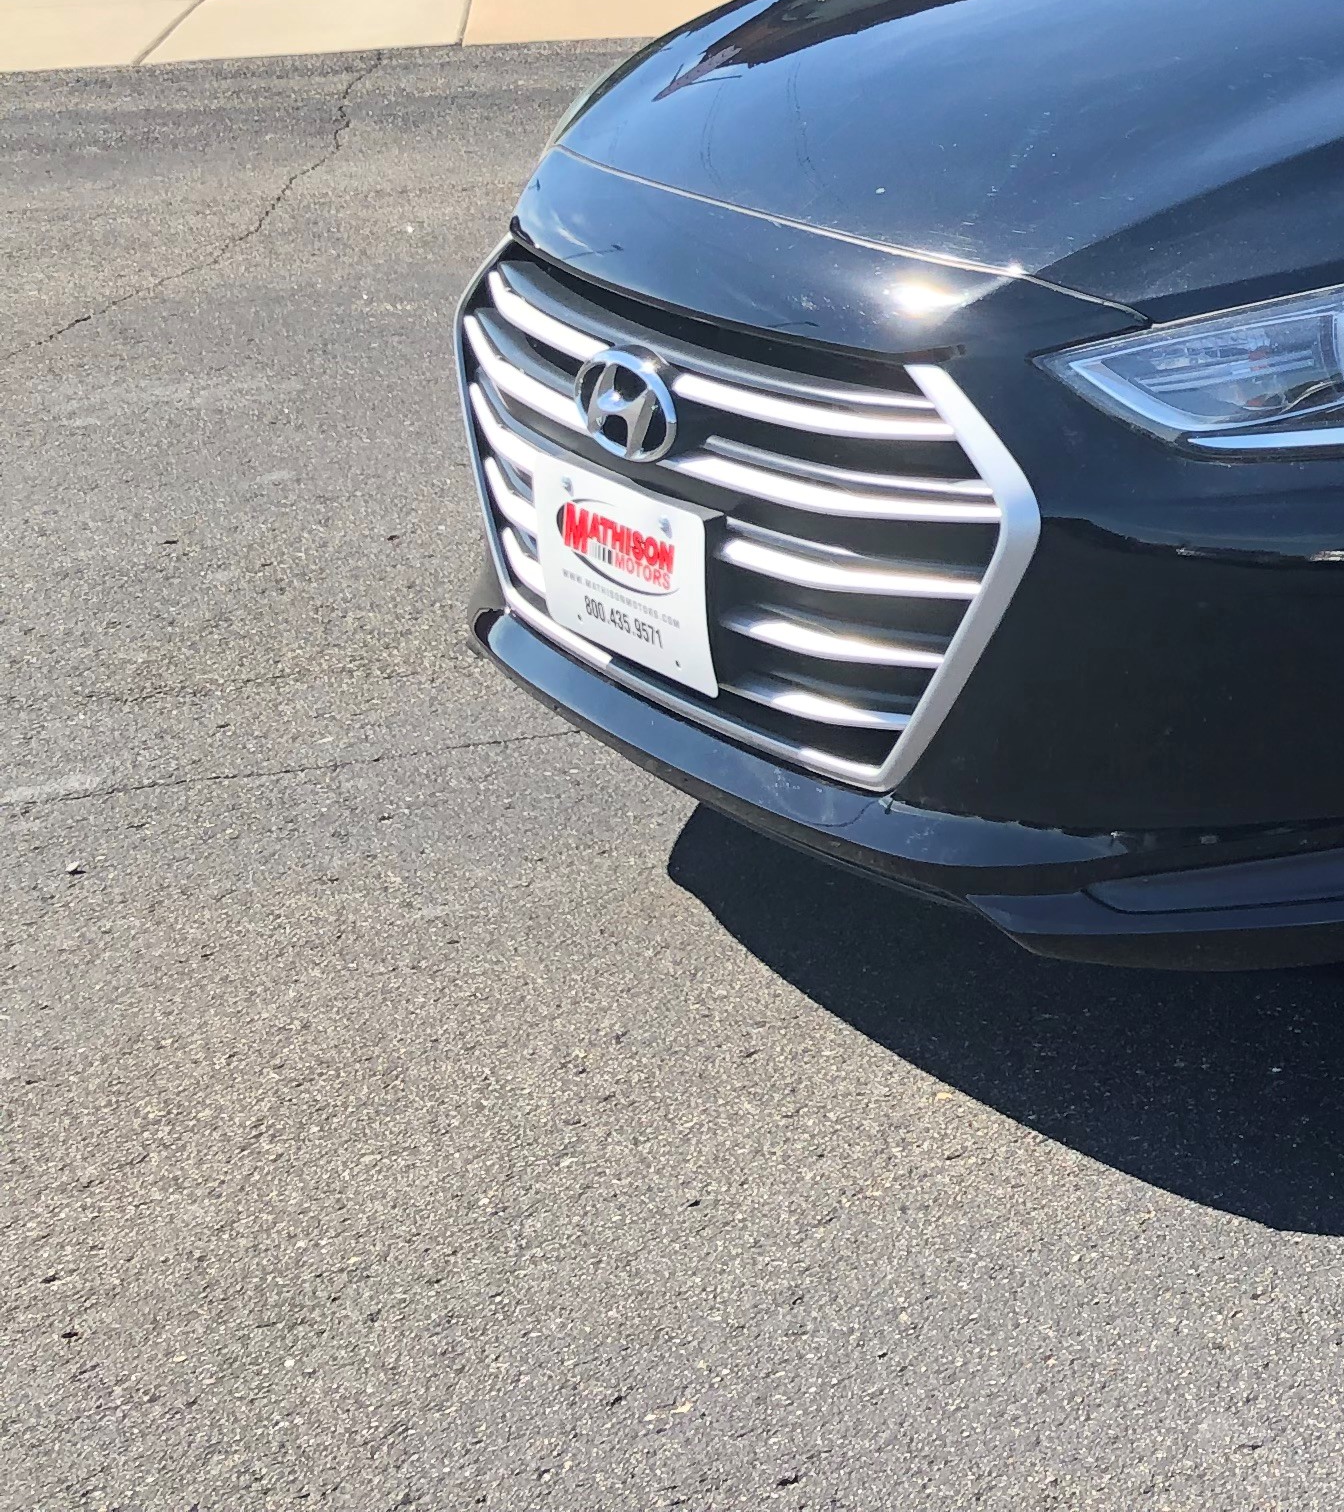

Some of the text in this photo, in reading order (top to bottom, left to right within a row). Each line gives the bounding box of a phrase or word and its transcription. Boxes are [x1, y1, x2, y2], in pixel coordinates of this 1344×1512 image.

[563, 500, 676, 576] MATHISON
[614, 551, 672, 591] MOTORS
[584, 594, 664, 650] 800.435.9571
